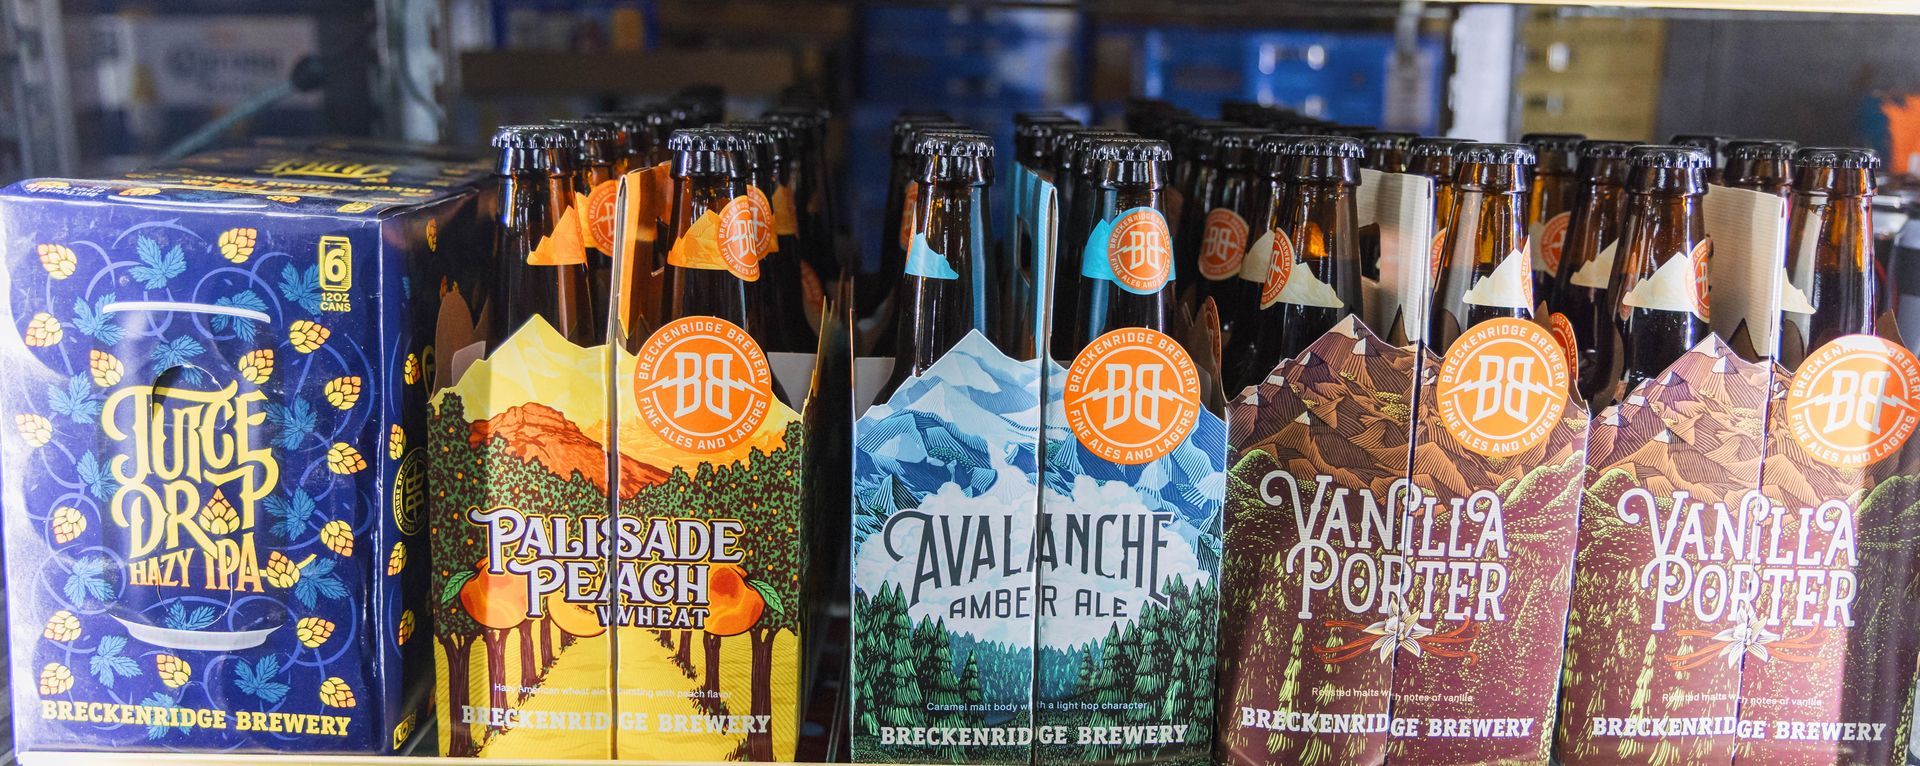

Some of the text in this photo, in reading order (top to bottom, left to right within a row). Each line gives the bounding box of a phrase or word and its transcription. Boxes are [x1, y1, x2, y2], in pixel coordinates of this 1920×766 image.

[324, 248, 347, 282] 6
[1121, 275, 1142, 288] ALES
[320, 302, 352, 313] CANS
[321, 292, 350, 303] 12OZ
[638, 321, 769, 385] BRECKENRIDGE BREWERY
[1068, 332, 1155, 393] BRECKENRIDGE
[1157, 340, 1198, 394] BREWERY
[1442, 324, 1566, 389] BRECKENRIDGE BREWERY
[1792, 344, 1870, 398] BRECKEN
[101, 380, 272, 482] JUICE
[640, 396, 767, 450] FINE ALES AND LAGERS
[1070, 409, 1194, 462] FINE ALES AND LAGERS
[1441, 399, 1561, 453] FINE ALES AND LAGERS
[1791, 413, 1916, 465] FINE ALES AND LAGERS
[1259, 470, 1510, 559] VANILLA
[1616, 488, 1860, 566] VANILLA
[129, 531, 265, 593] HAZY IPA
[468, 507, 745, 576] PALISADE
[883, 509, 1174, 609] AVALANCHE
[507, 559, 711, 619] PEACH
[949, 585, 1128, 619] AMBER ALE
[1286, 539, 1507, 621] PORTER
[1641, 555, 1858, 631] PORTER
[599, 606, 711, 629] WHEAT
[41, 699, 351, 736] BRECKENRIDGE BREWERY
[461, 705, 771, 734] BRECKENRIDGE BREWERY
[676, 689, 704, 700] peach
[926, 702, 967, 711] Caramel
[970, 702, 991, 711] malt
[994, 702, 1018, 712] body
[1056, 701, 1079, 711] light
[1081, 701, 1099, 711] hop
[1353, 687, 1379, 697] malts
[1403, 693, 1430, 702] notes
[1431, 693, 1442, 701] of
[1701, 692, 1727, 701] malts
[881, 724, 1188, 746] BRECKENRIDGE BREWERY
[1241, 706, 1534, 738] BRECKENRIDGE BREWERY
[1592, 717, 1886, 741] BRECKENRIDGE BREWERY
